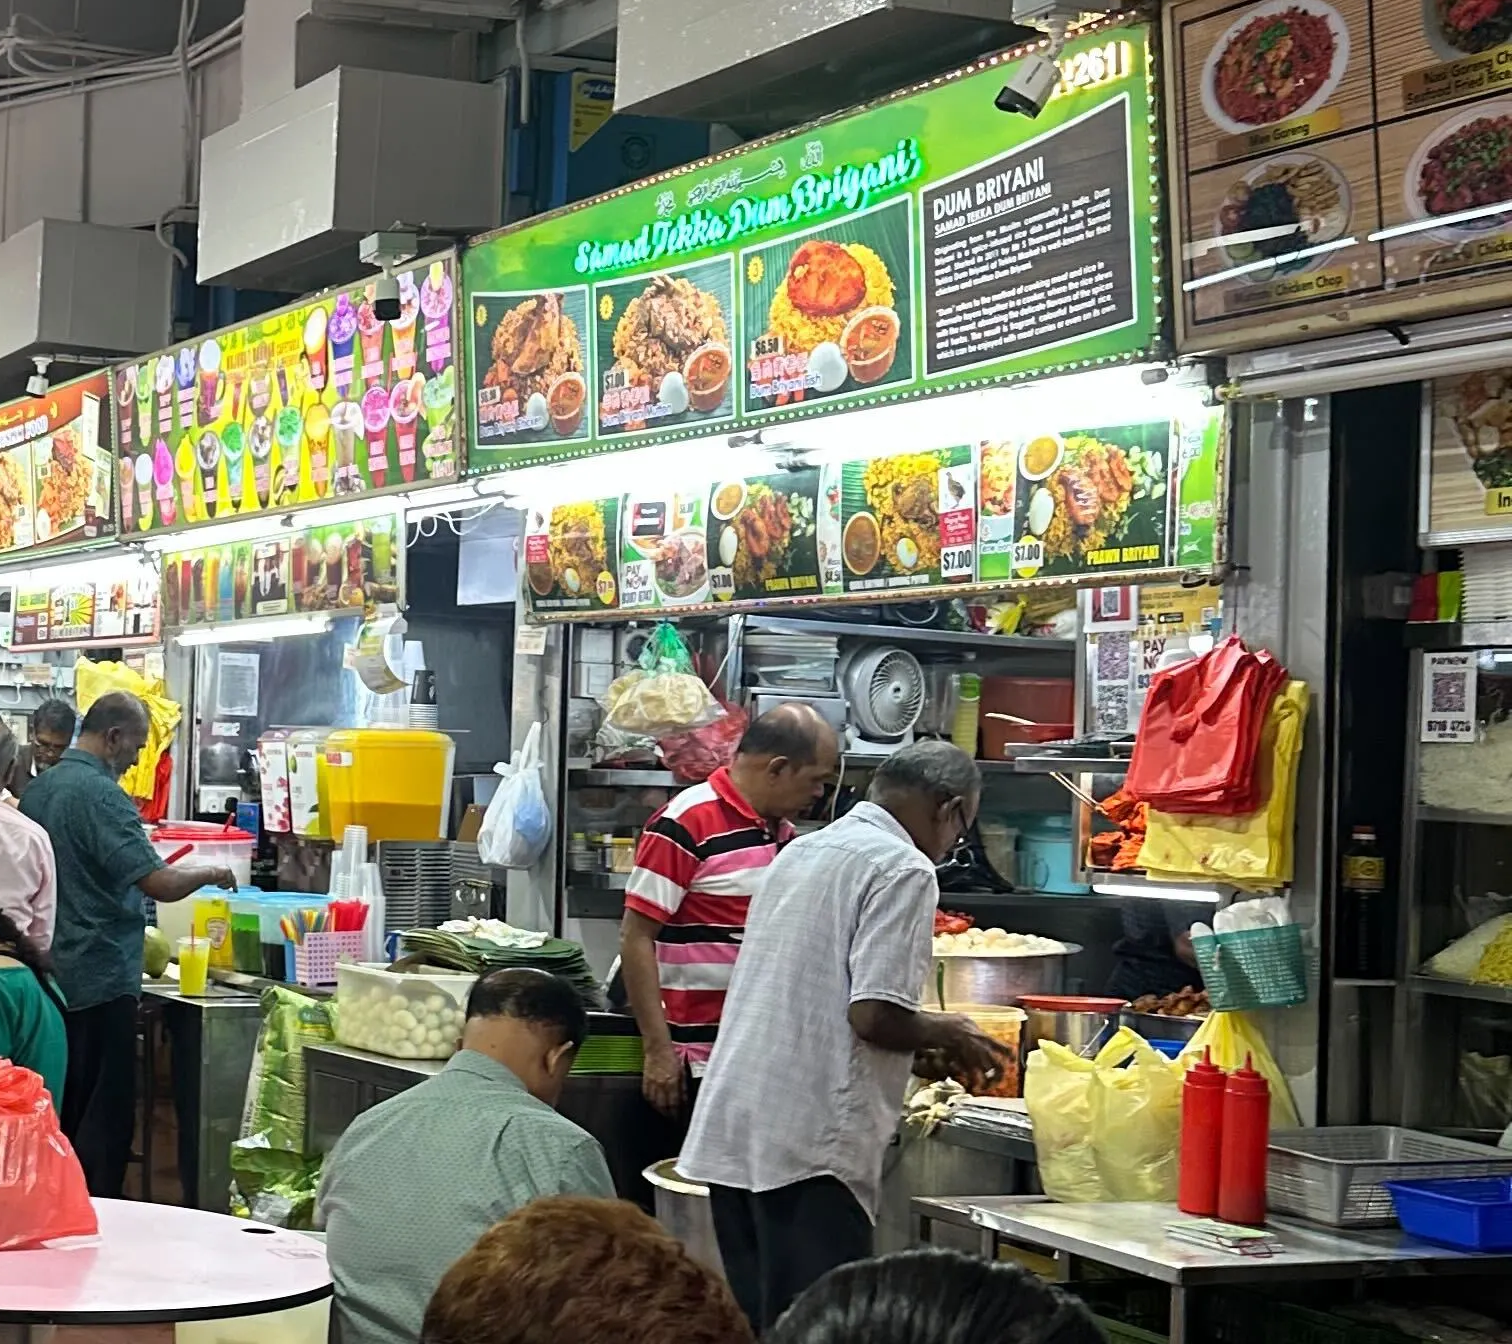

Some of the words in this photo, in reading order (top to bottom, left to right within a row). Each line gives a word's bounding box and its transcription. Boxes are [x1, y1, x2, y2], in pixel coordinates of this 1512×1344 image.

[1452, 55, 1493, 77] Goreng
[1496, 49, 1512, 66] Ch
[1273, 123, 1309, 142] Goreng
[933, 187, 973, 221] DUM
[976, 157, 1045, 205] BRIYANI
[574, 227, 652, 272] Samad
[652, 209, 727, 257] Tekka
[727, 194, 793, 238] Dum
[792, 138, 921, 211] Briyani
[935, 216, 966, 235] SAMAD
[967, 206, 992, 224] TEKKA
[994, 197, 1015, 214] DUM
[1016, 182, 1051, 205] BRIYANI
[1478, 239, 1512, 256] Chicke
[1316, 273, 1343, 291] Chop
[755, 337, 778, 356] $6.50
[604, 372, 625, 390] $7.00
[1497, 491, 1512, 508] In
[943, 550, 971, 571] $7.00
[1015, 544, 1040, 562] $7.00
[1087, 549, 1120, 565] PRAWN
[1122, 544, 1159, 562] BRIYANI
[626, 564, 641, 576] PAY
[626, 574, 648, 589] NOW
[1143, 638, 1167, 655] PAY
